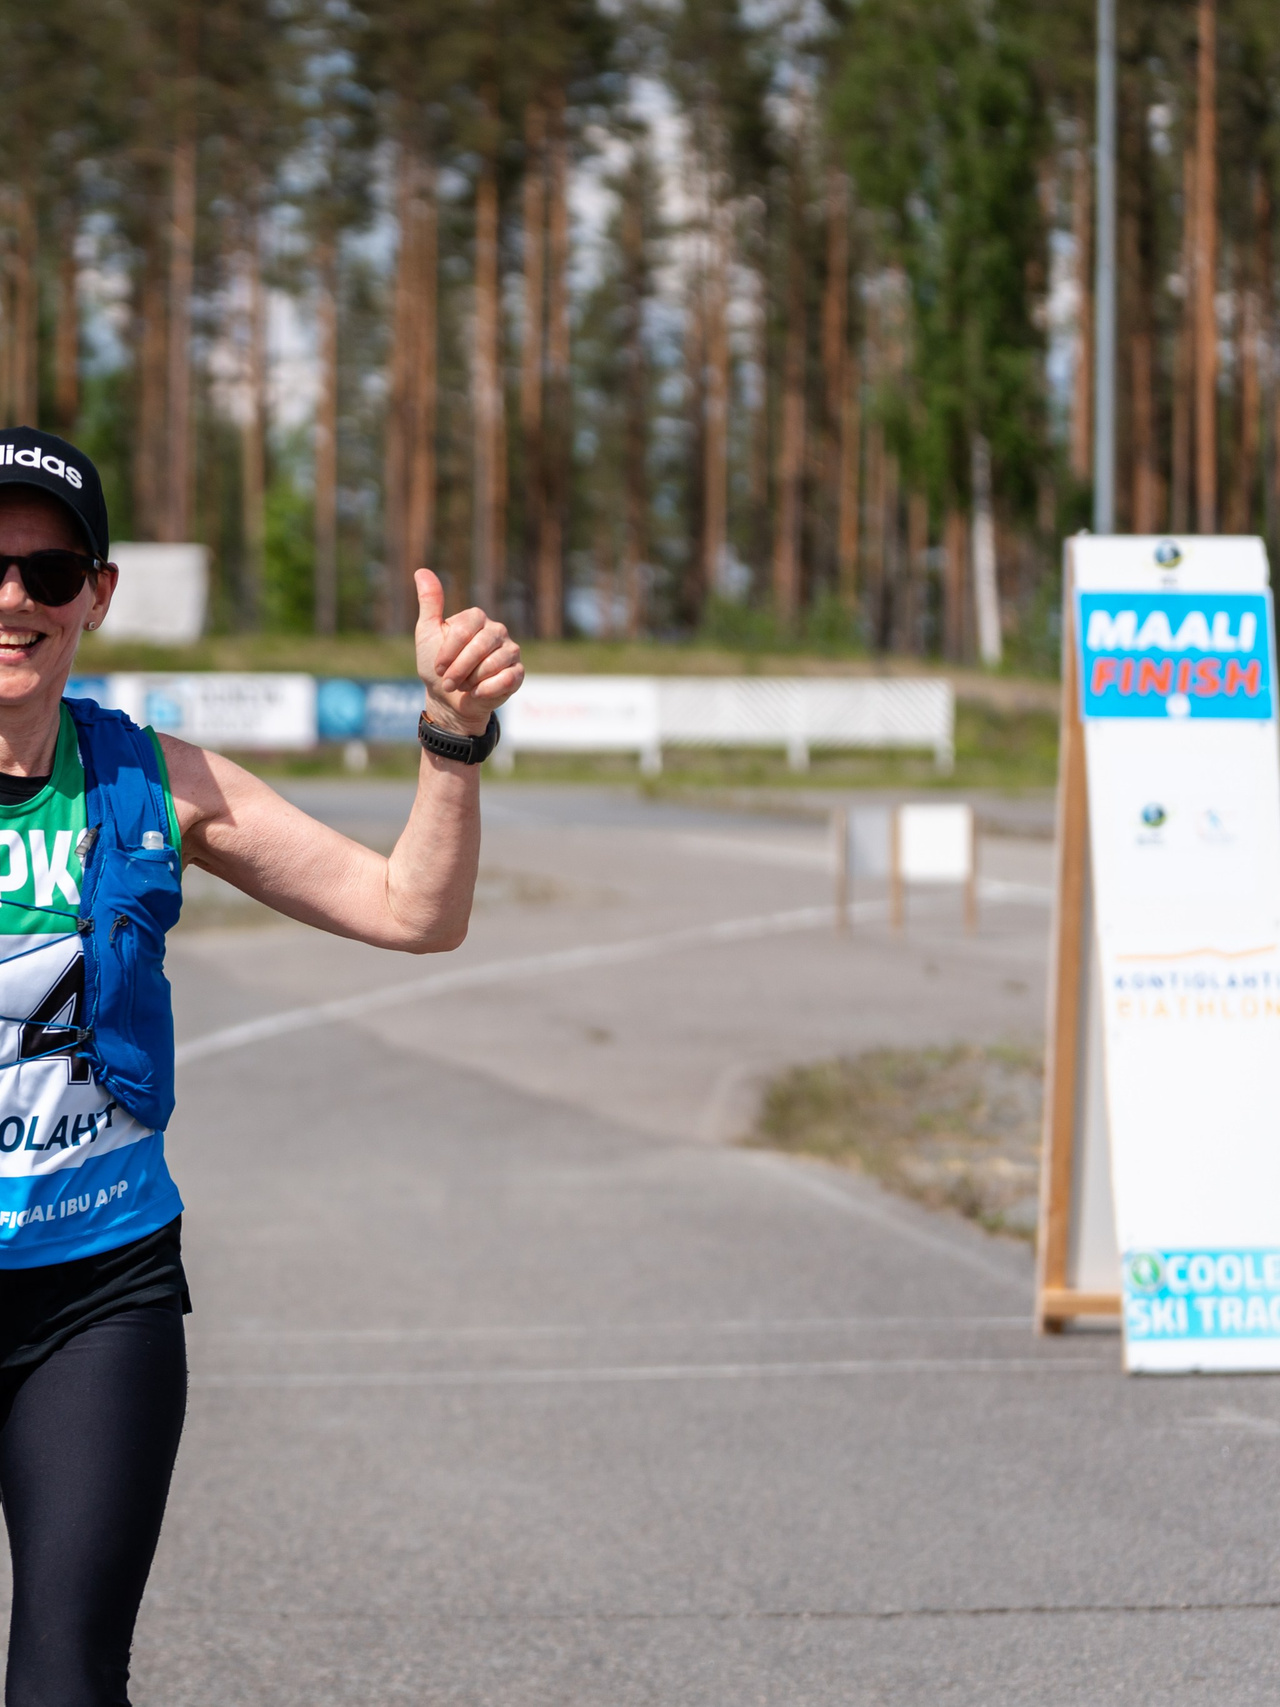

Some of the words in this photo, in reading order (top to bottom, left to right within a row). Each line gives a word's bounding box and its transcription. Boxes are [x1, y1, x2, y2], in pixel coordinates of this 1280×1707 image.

[1086, 610, 1258, 653] MAALI
[1090, 657, 1262, 697] FINISH
[60, 1194, 91, 1218] IBU
[95, 1181, 129, 1208] APP
[1128, 1297, 1189, 1335] SKI
